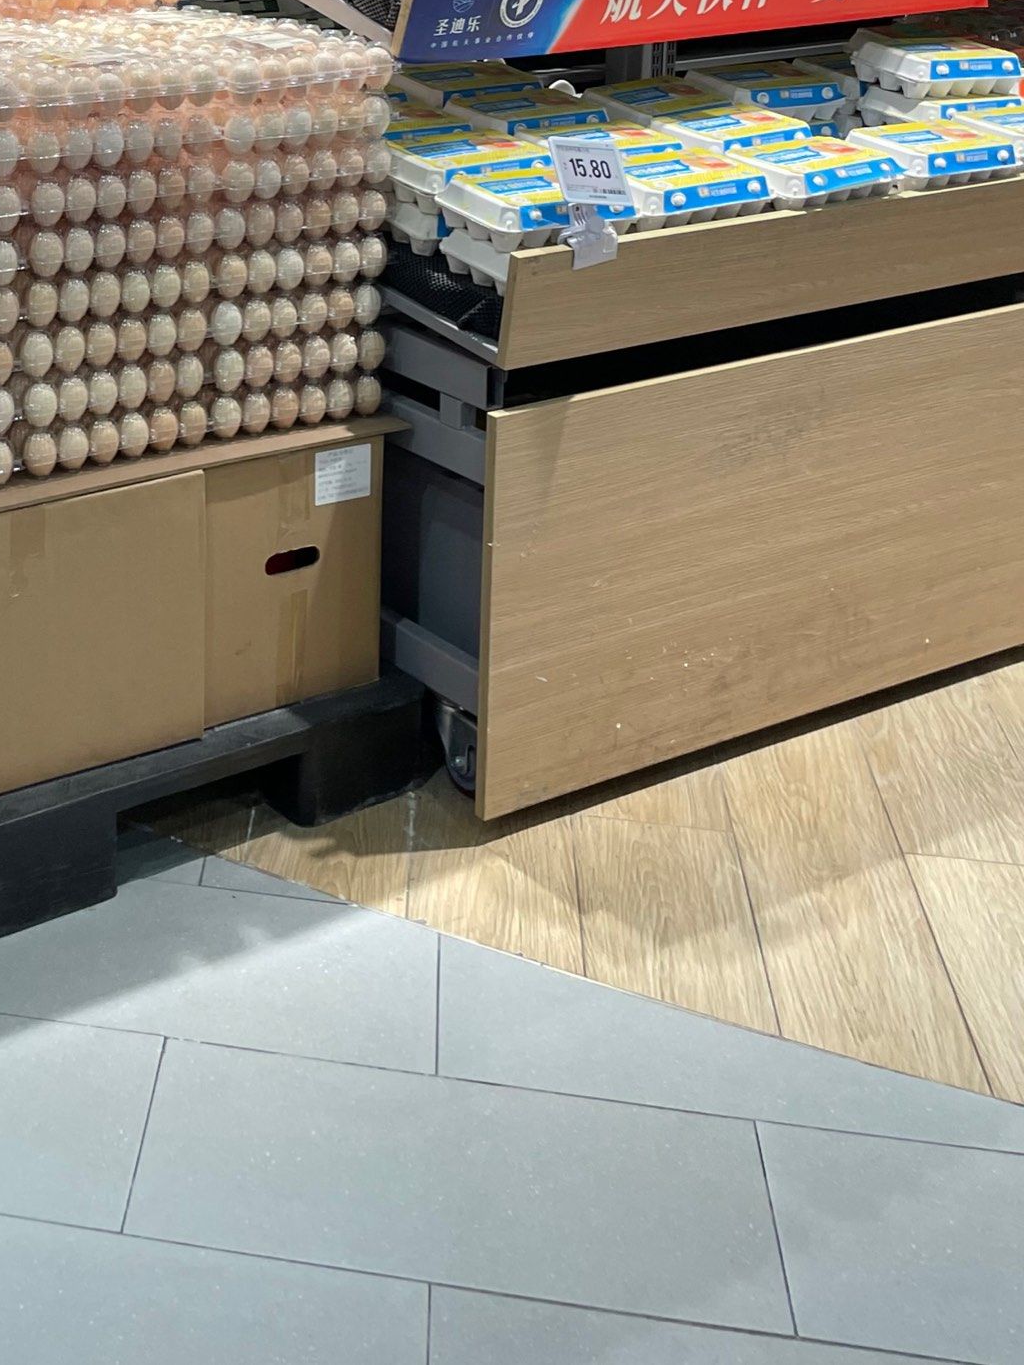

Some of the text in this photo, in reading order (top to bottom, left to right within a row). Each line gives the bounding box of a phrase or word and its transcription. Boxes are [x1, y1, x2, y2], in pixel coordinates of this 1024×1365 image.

[433, 14, 483, 37] 圣迪乐
[569, 158, 612, 180] 15.80
